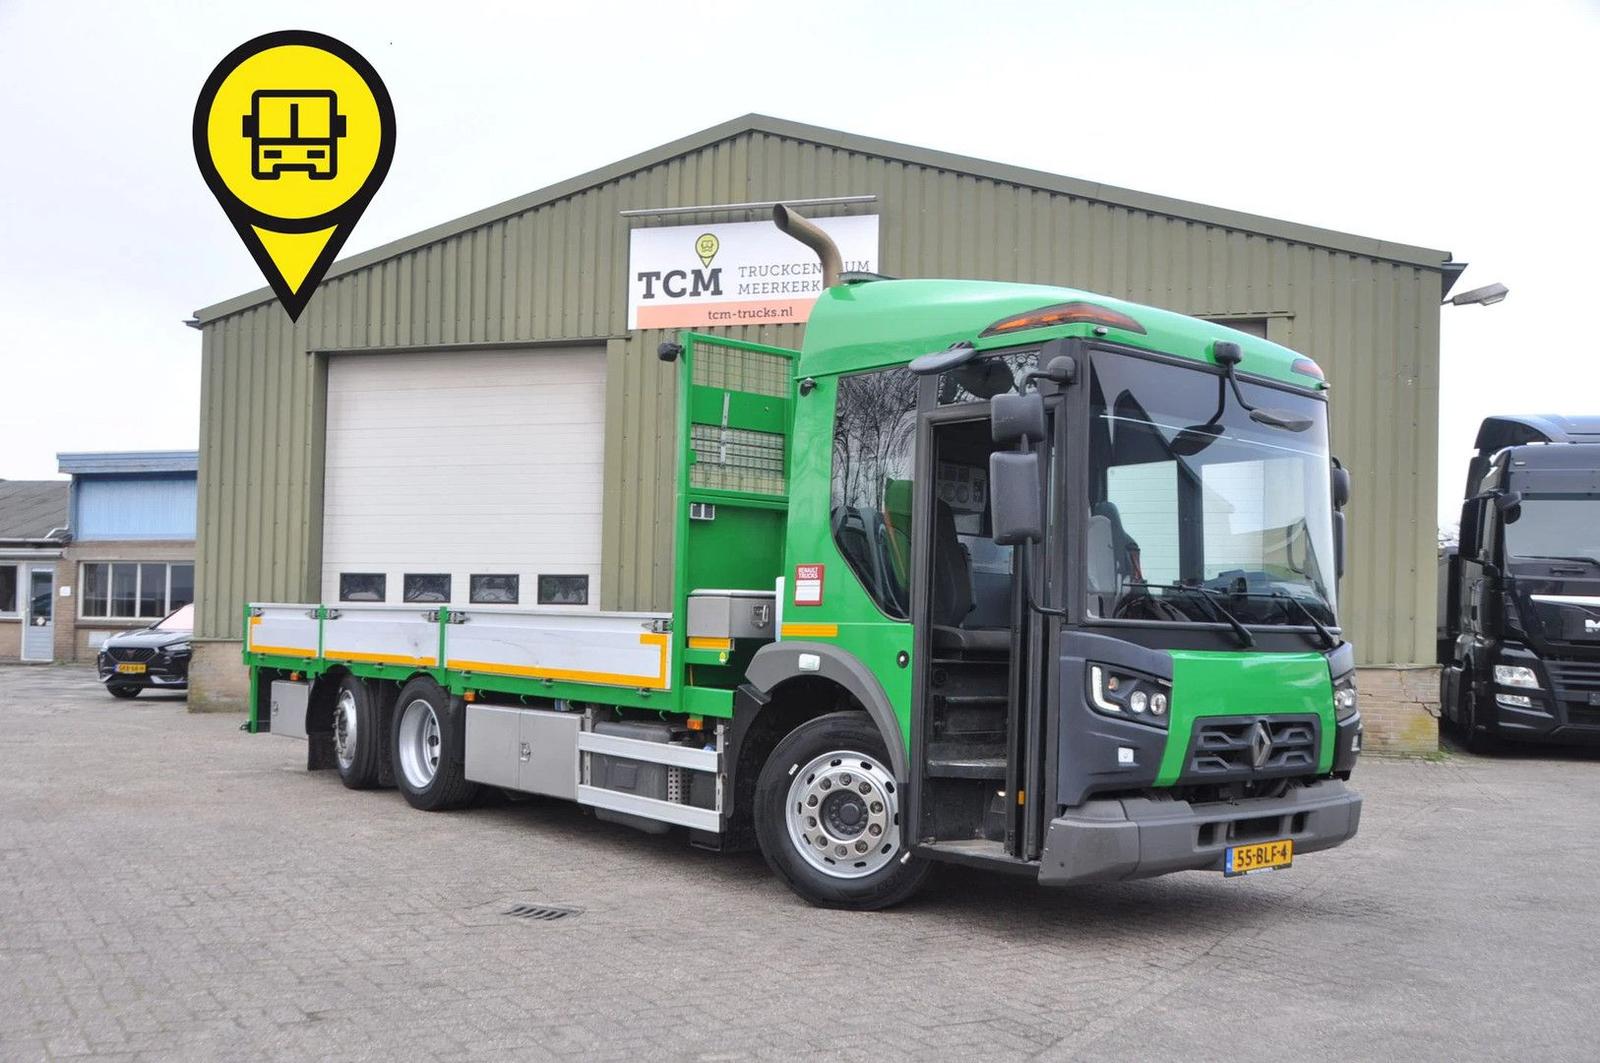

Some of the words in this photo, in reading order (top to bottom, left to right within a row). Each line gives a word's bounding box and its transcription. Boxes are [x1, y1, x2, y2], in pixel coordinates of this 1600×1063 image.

[738, 260, 870, 278] TRUCKCENUM
[637, 267, 723, 299] TCM
[738, 280, 820, 295] MEERKERK
[708, 306, 793, 320] tcm-trucks.nl
[1237, 844, 1287, 867] 55-BLF-4
